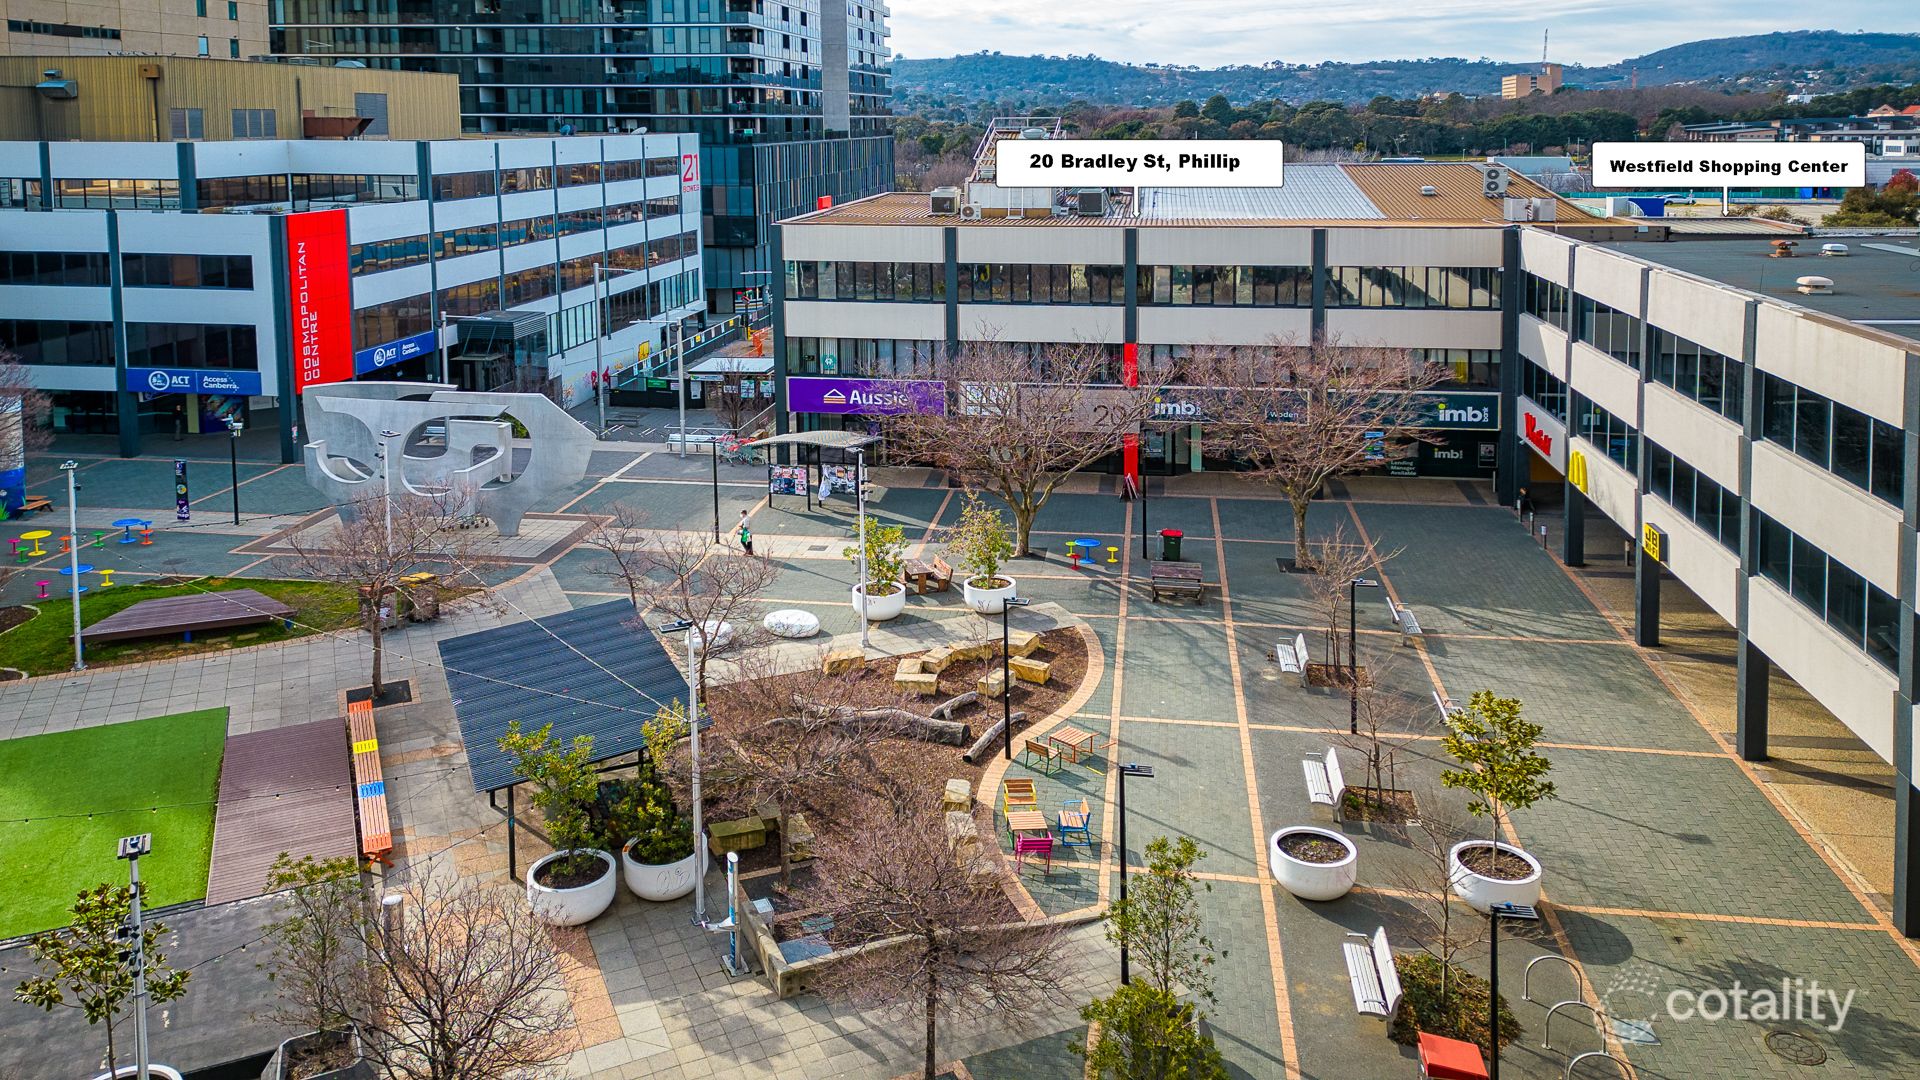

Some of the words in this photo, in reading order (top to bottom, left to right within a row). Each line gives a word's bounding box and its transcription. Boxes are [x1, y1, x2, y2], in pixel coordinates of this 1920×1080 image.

[682, 153, 699, 182] 21
[298, 242, 312, 382] COSMOPOLITAN
[310, 311, 321, 379] CENTRE
[386, 347, 397, 357] ACT
[171, 375, 190, 385] ACT
[203, 375, 228, 383] Access
[203, 381, 238, 389] Canberra
[849, 389, 909, 405] Aussie
[1154, 396, 1196, 415] imb
[1438, 403, 1483, 422] imb
[1434, 448, 1460, 459] imb
[1645, 528, 1658, 548] JB
